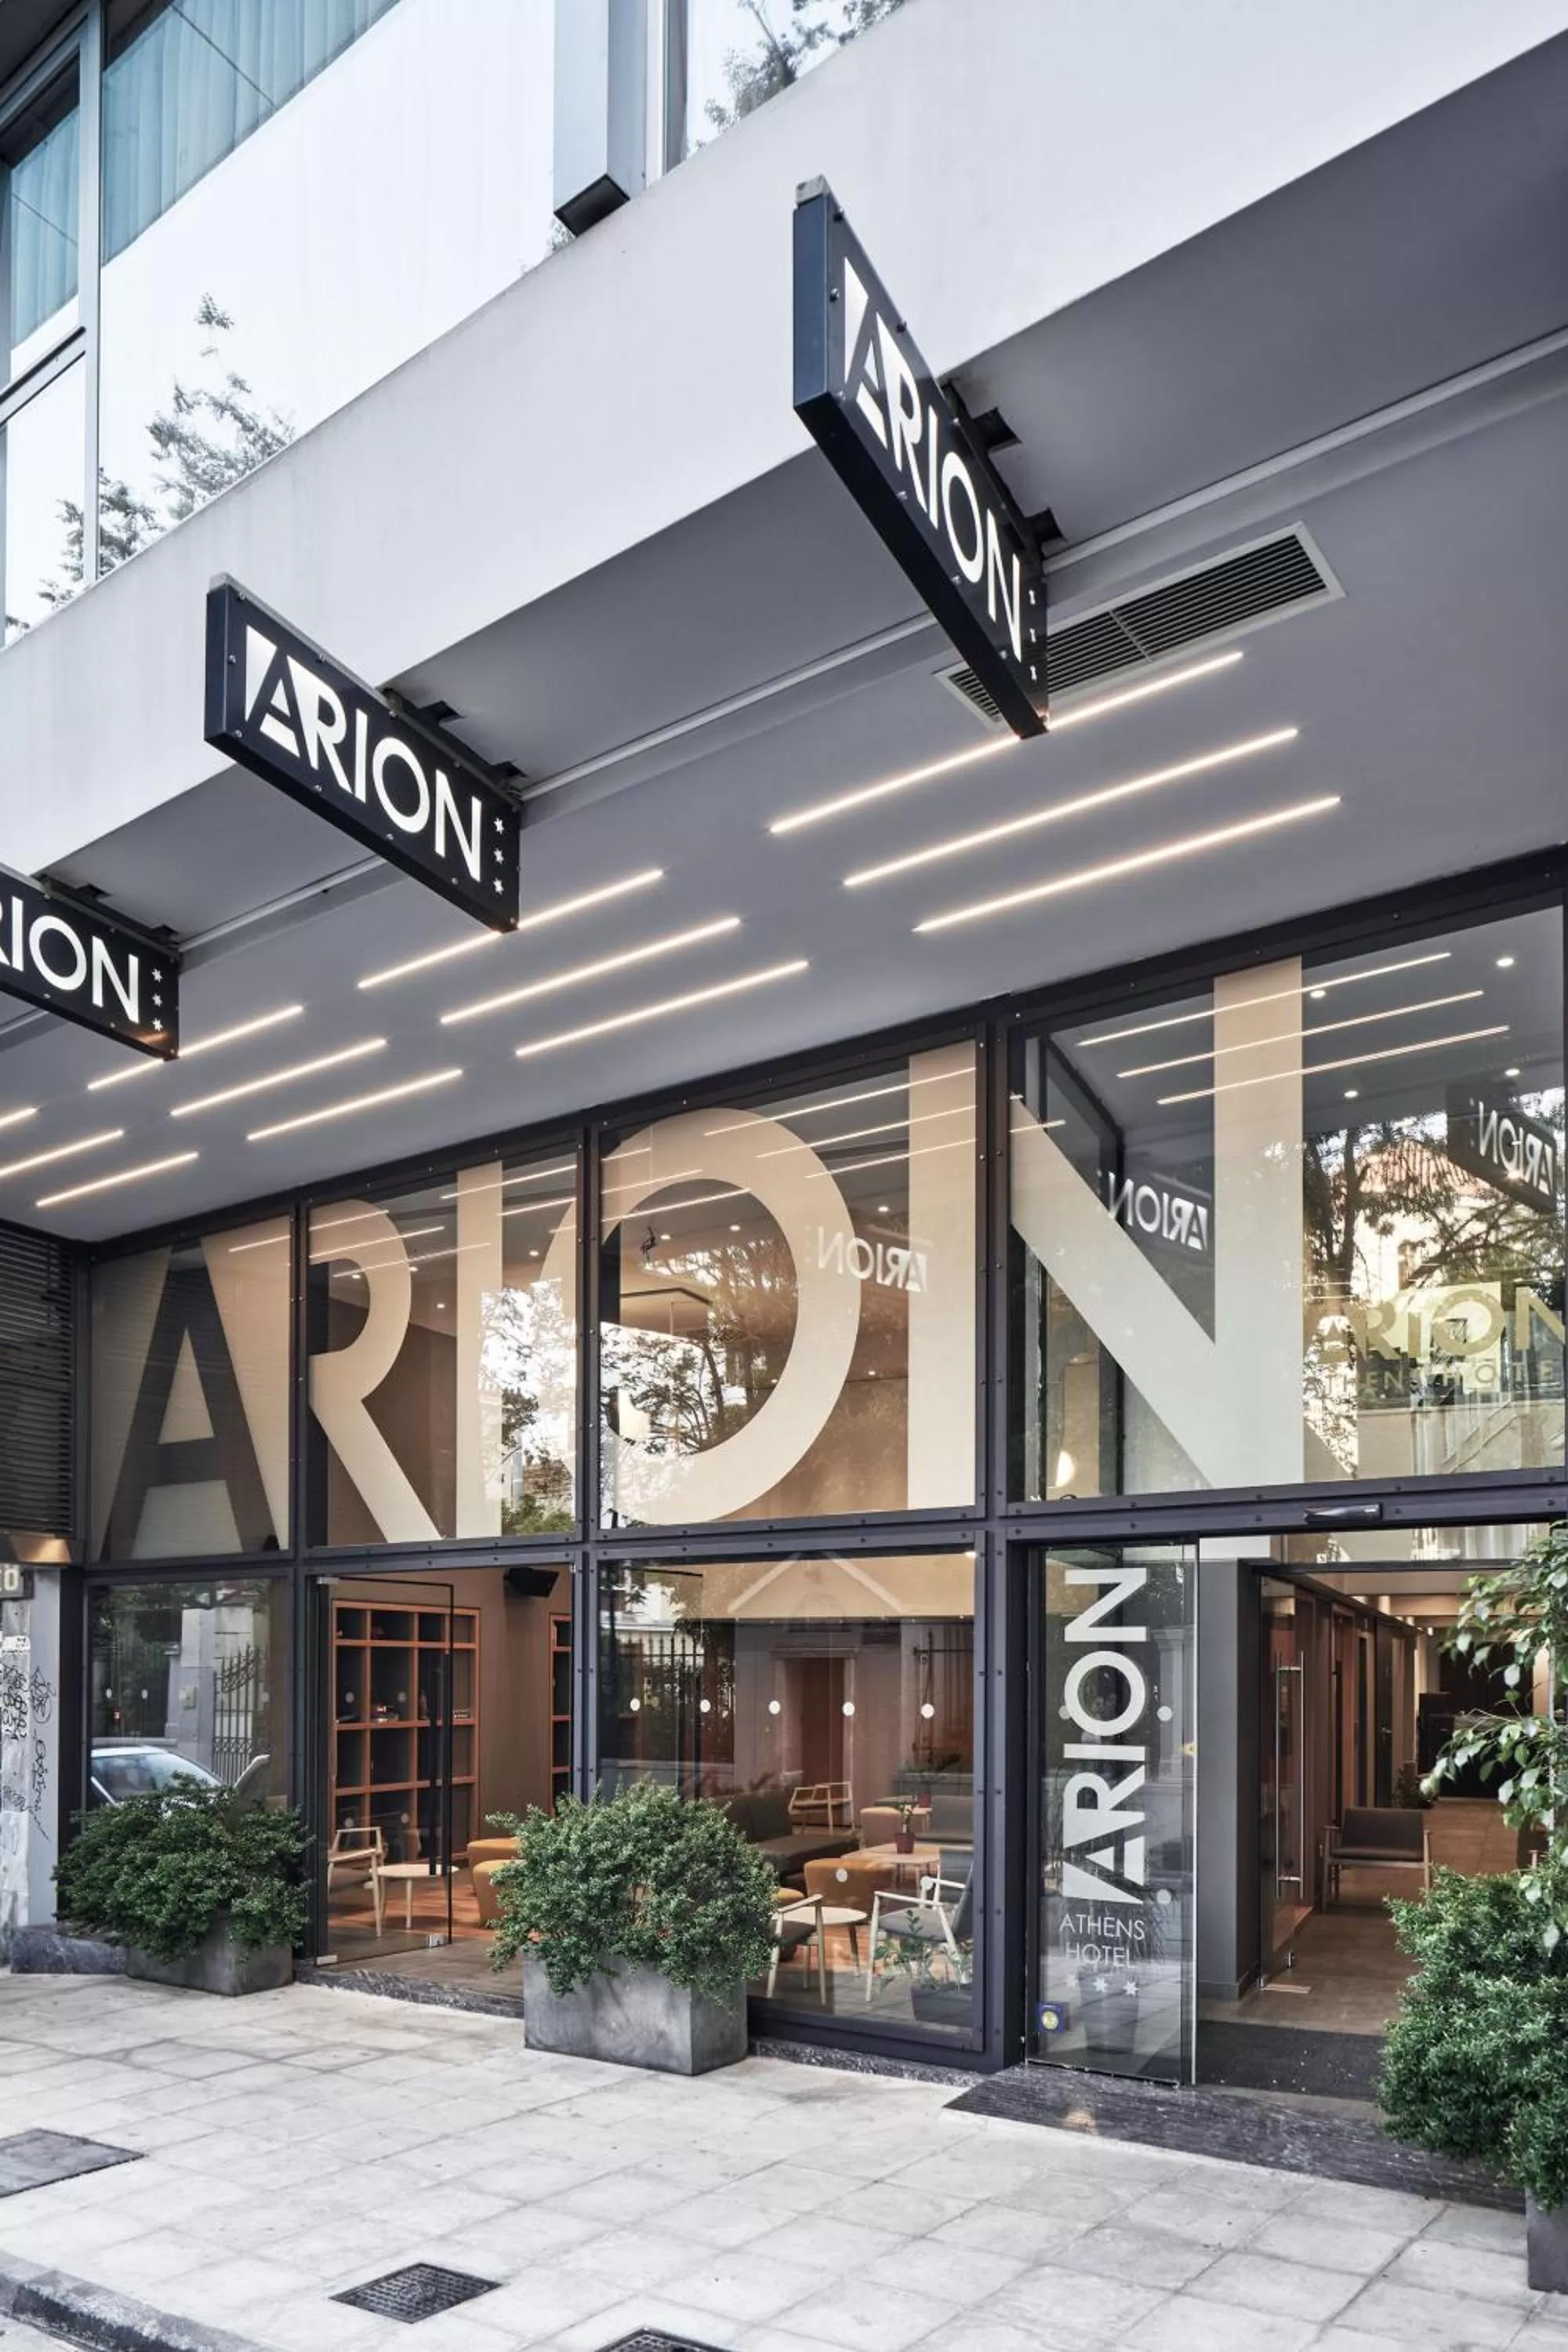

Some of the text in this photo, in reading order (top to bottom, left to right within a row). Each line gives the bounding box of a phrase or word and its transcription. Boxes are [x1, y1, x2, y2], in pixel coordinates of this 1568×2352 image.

[844, 257, 1022, 662] ARION
[245, 625, 482, 882] ARION
[0, 895, 139, 1024] ION
[91, 956, 1303, 1559] ARION
[1062, 1567, 1147, 1905] ARION
[1058, 1912, 1145, 1940] ATHENS
[1065, 1941, 1137, 1969] HOTEL
